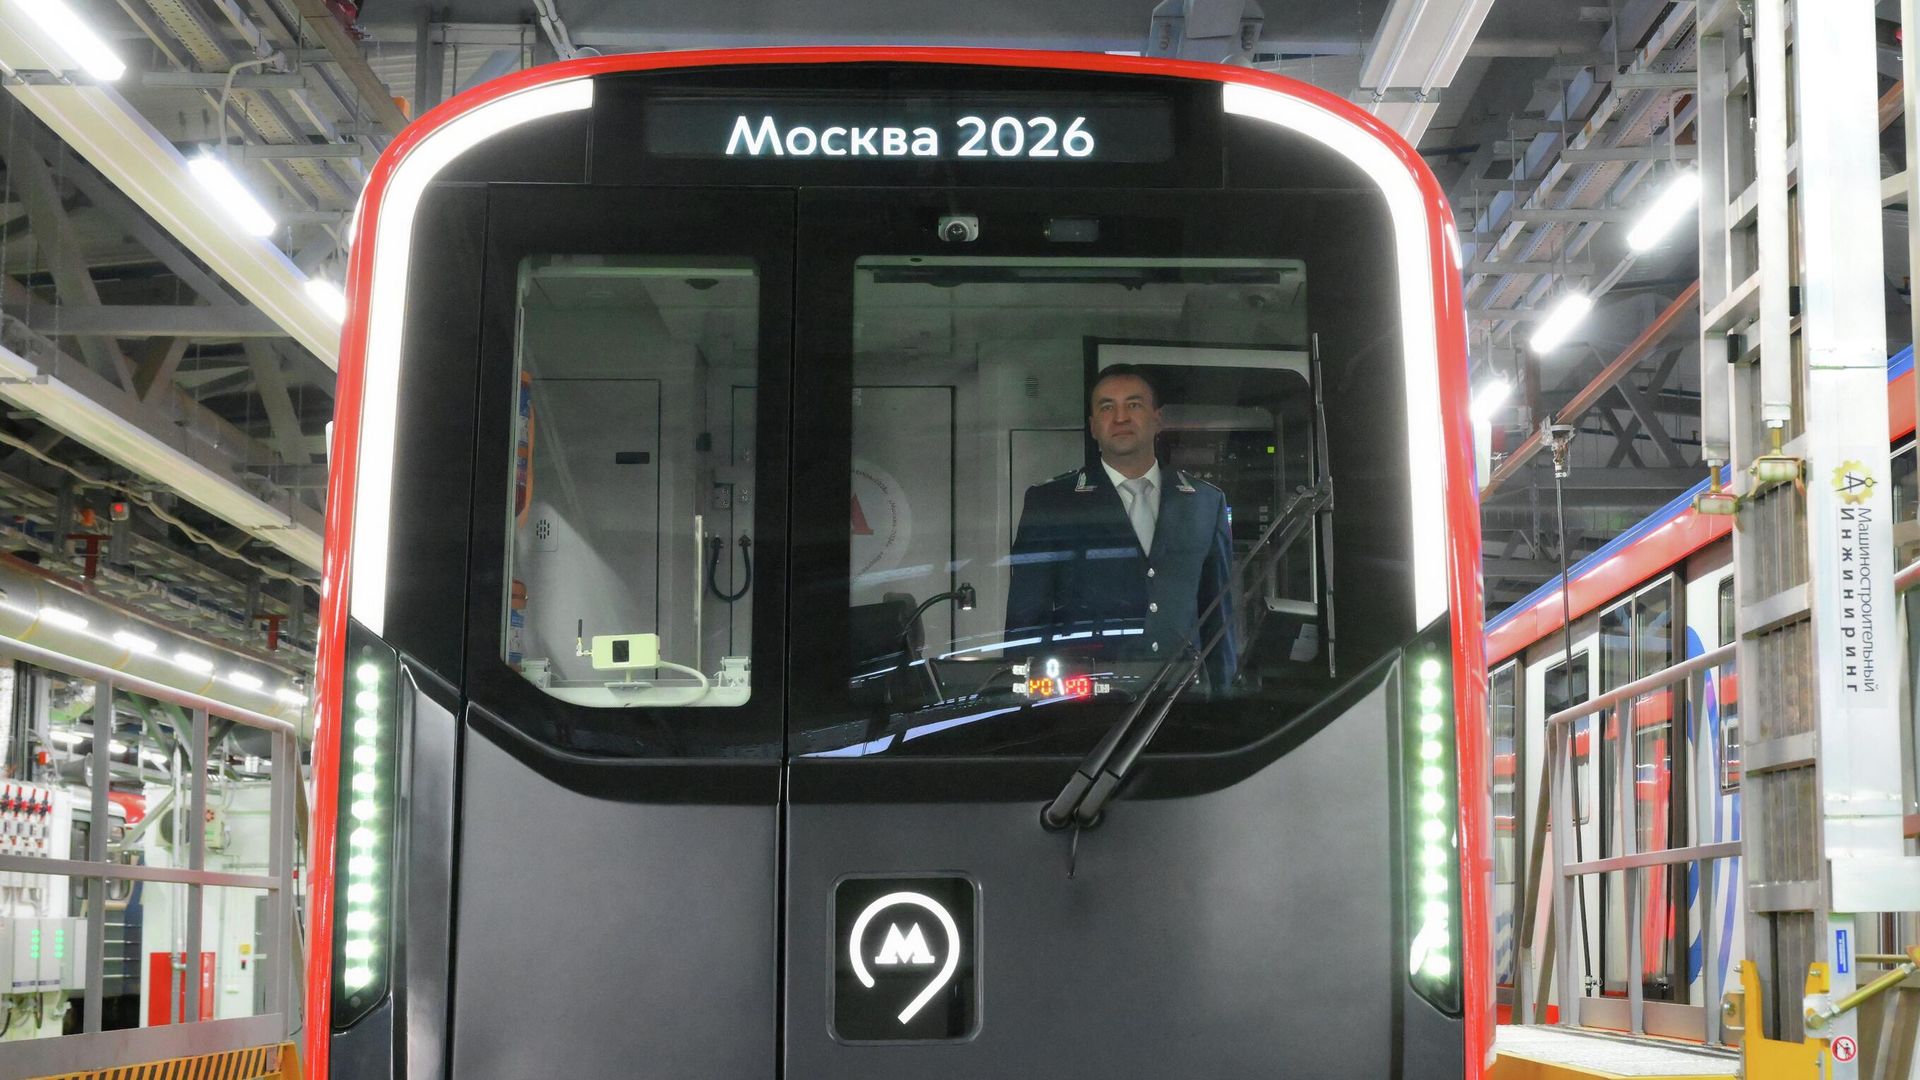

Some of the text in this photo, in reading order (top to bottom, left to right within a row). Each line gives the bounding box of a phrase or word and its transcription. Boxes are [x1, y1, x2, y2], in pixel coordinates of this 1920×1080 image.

[725, 114, 1095, 157] Москва 2026
[1857, 507, 1879, 693] Машиностроительный
